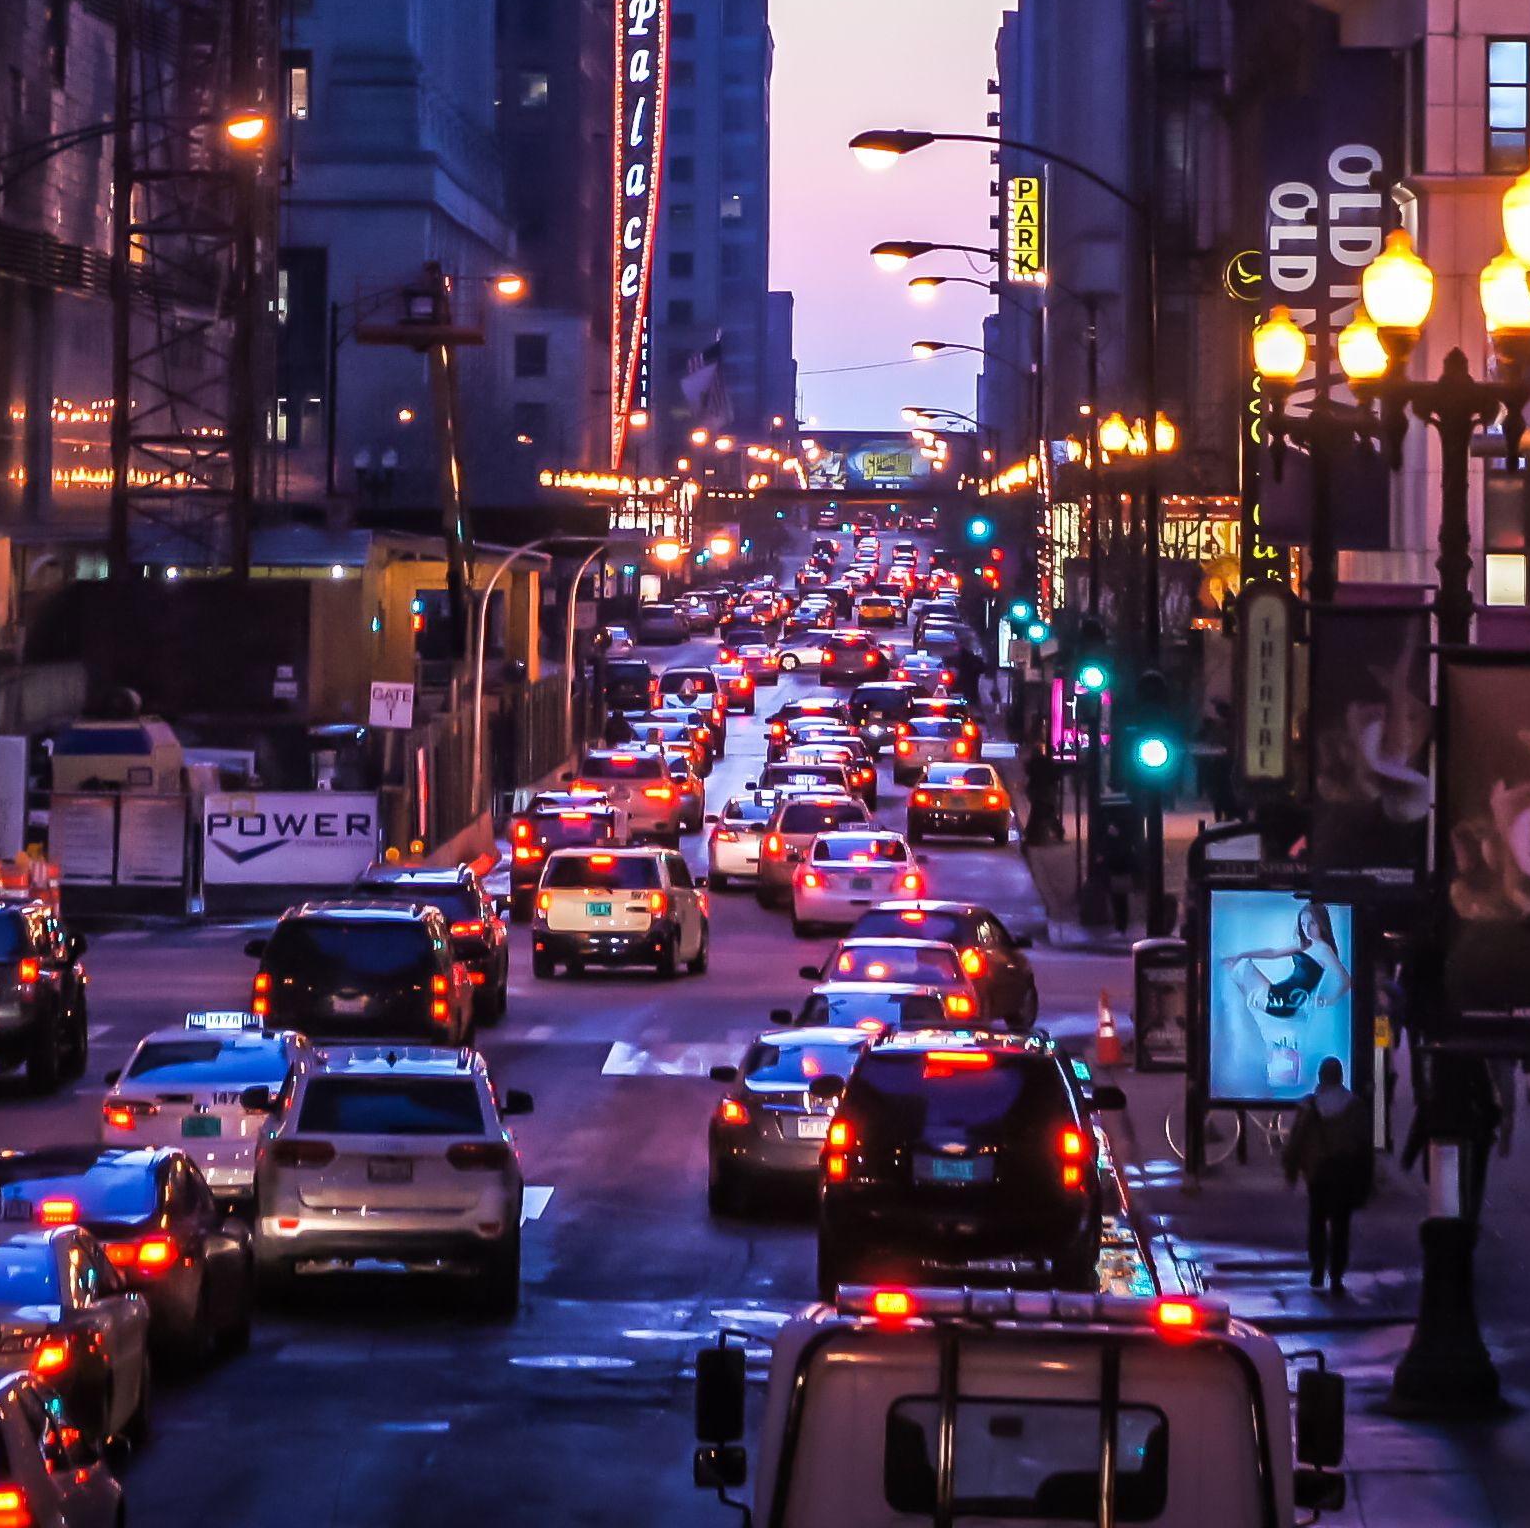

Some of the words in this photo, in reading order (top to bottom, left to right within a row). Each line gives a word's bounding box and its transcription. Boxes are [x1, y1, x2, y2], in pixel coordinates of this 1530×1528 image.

[1016, 179, 1035, 271] PARK
[1269, 182, 1318, 292] OLD
[1327, 144, 1383, 267] OLD
[640, 316, 648, 408] THEATR
[371, 687, 412, 703] GATE
[207, 813, 372, 837] POWER
